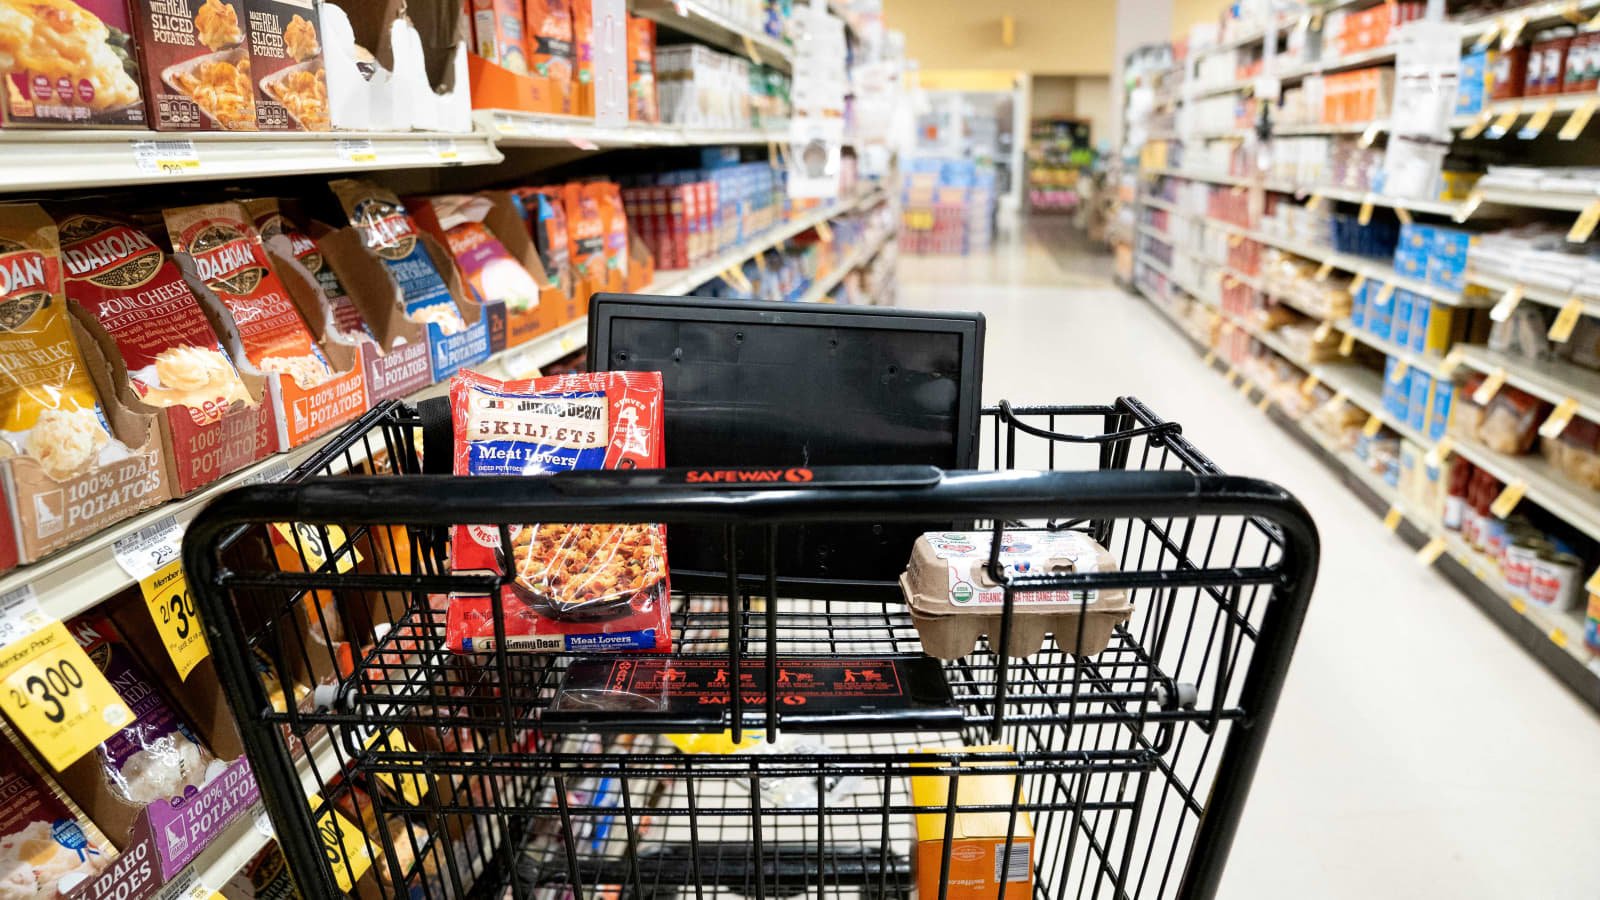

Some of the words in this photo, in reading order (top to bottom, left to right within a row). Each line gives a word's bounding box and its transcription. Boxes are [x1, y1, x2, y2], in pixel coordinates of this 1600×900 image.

[151, 14, 194, 33] SLICED
[262, 13, 282, 34] REAL
[153, 29, 195, 46] POTATOES
[252, 32, 283, 47] SLICED
[253, 45, 284, 58] POTATOES
[61, 230, 157, 275] IDAHOAN
[193, 243, 257, 281] IDAHOAN
[98, 298, 138, 318] FOUR
[137, 279, 191, 307] CHEESE
[383, 350, 405, 370] 100%
[404, 343, 426, 361] IDAHO
[384, 357, 428, 386] POTATOES
[310, 387, 335, 409] 100%
[335, 374, 363, 398] IDAHO
[310, 389, 363, 428] POTATOES
[567, 402, 602, 421] Dean
[614, 399, 646, 411] SERVES
[189, 423, 226, 454] 100%
[229, 408, 268, 438] IDAHO
[479, 420, 596, 444] SKILLETS
[191, 428, 268, 479] POTATOES
[478, 445, 522, 461] Meat
[524, 448, 577, 466] Lovers
[68, 471, 115, 503] 100%
[685, 470, 783, 483] SAFEWAY
[68, 469, 161, 528] POTATOES
[153, 569, 180, 591] Member
[978, 592, 1002, 603] ORGANIC
[504, 638, 537, 650] Jimmy
[536, 637, 560, 649] Dean
[570, 637, 597, 645] Meat
[598, 635, 632, 644] Lovers
[186, 783, 223, 823] 100%
[93, 842, 147, 899] IDAHO
